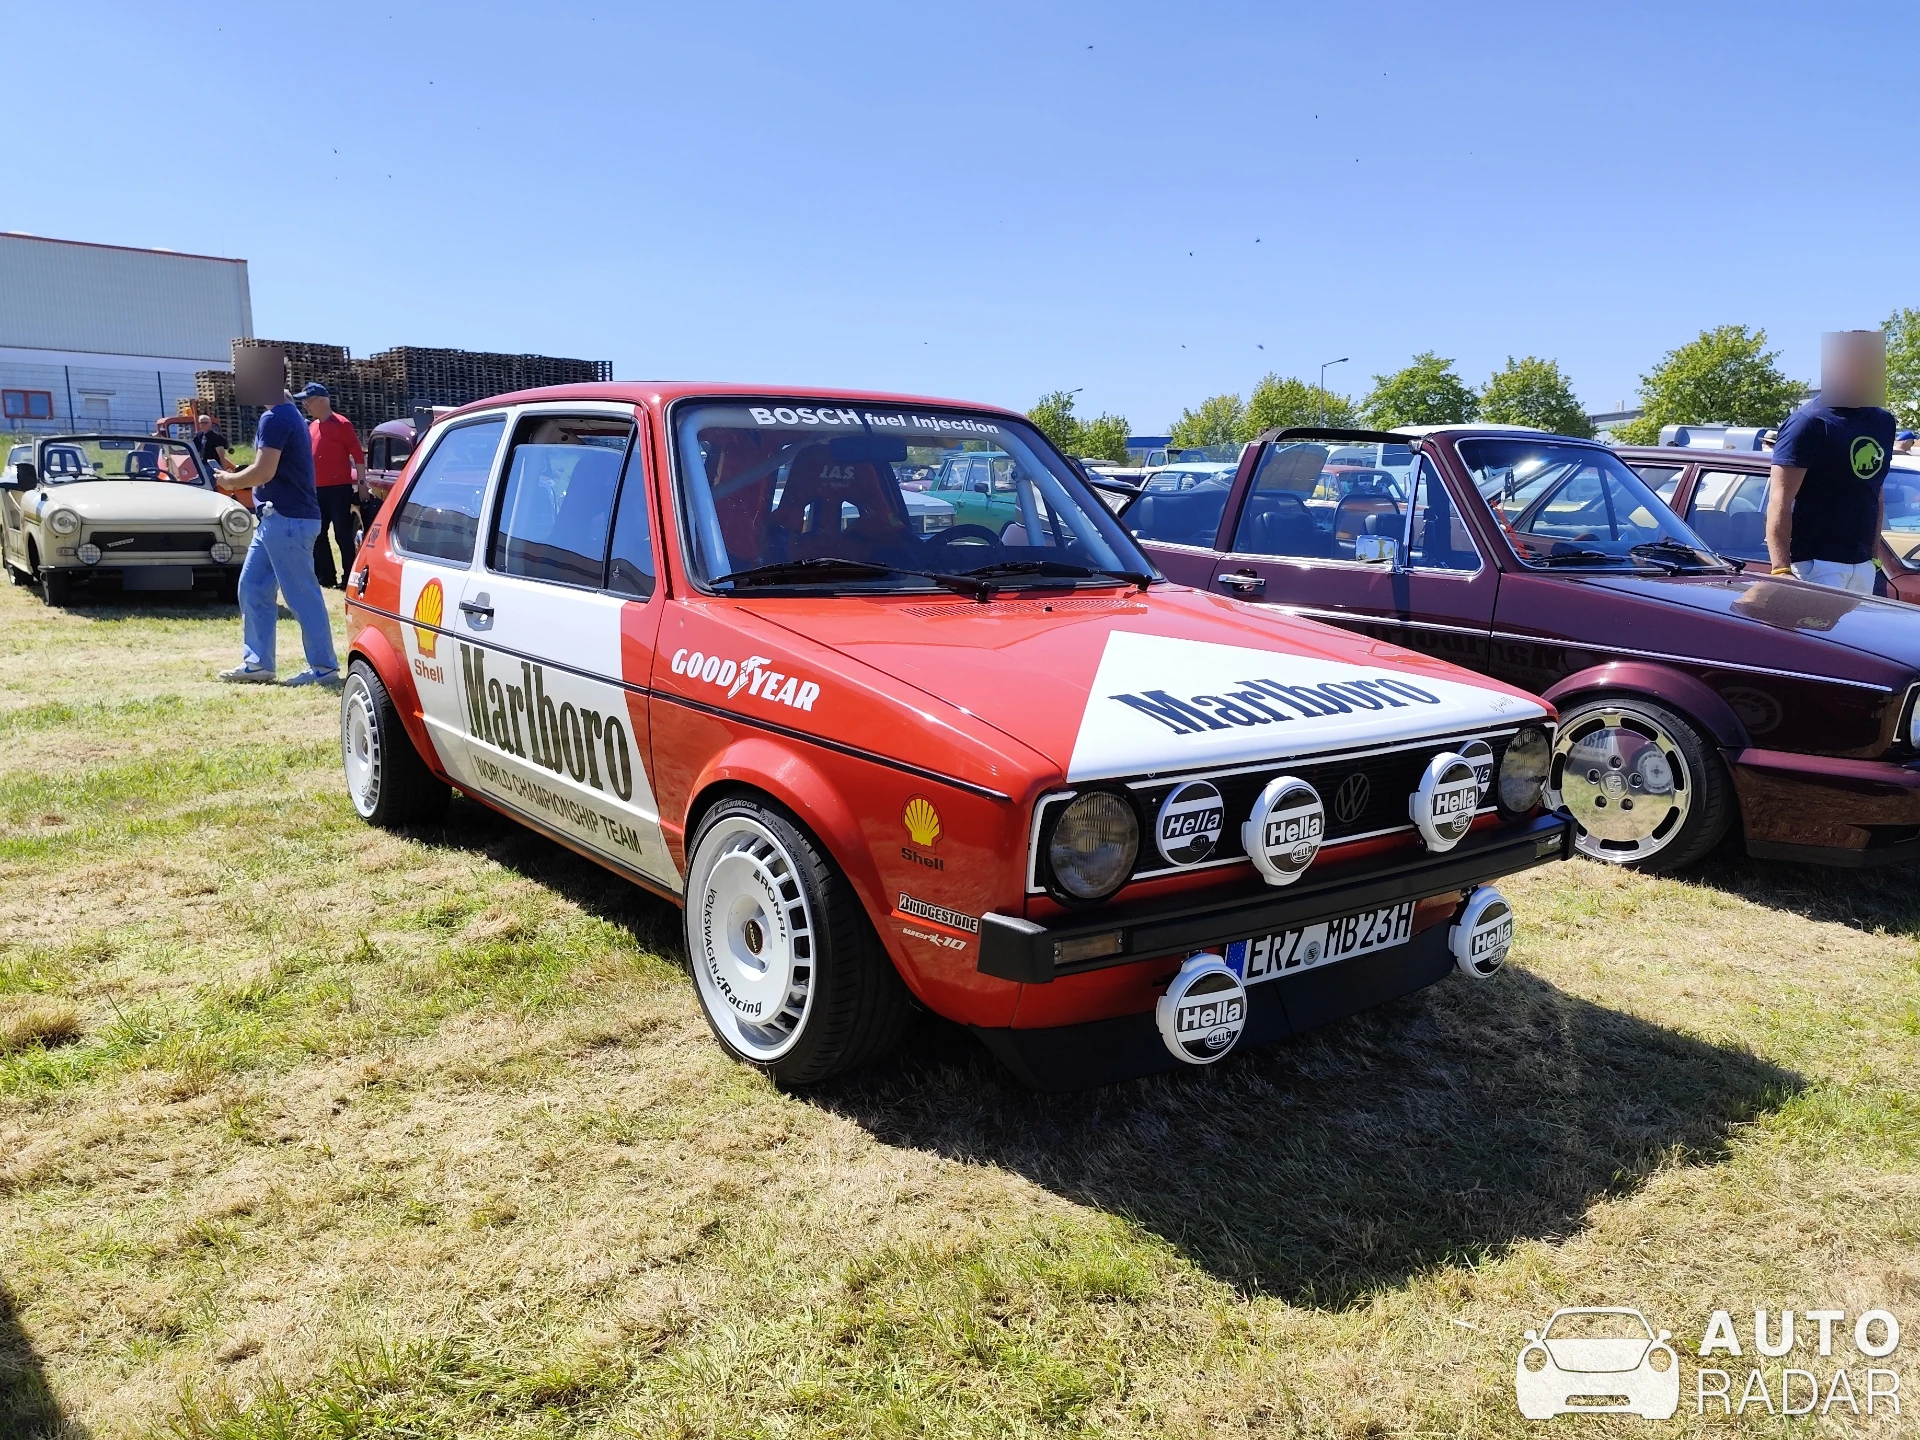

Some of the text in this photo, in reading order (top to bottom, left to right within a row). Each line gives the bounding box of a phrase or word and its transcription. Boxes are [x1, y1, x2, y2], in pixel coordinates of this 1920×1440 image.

[749, 407, 999, 434] BOSCH fuel Injection
[414, 658, 445, 684] Shell
[1107, 678, 1441, 735] Marlboro
[460, 643, 633, 802] Marlboro
[474, 755, 643, 855] WORLD CHAMPIONSHIP TEAM
[1436, 788, 1475, 815] Hella
[1165, 811, 1220, 837] Hella
[1269, 816, 1320, 845] Hella
[901, 848, 945, 872] Shell
[900, 894, 978, 932] BRIDGESTONE
[703, 888, 763, 1017] VOLKSWAGEN Racing
[1247, 927, 1303, 979] ERZ
[1474, 923, 1511, 955] Hella
[1181, 1003, 1241, 1031] Hella
[1207, 1030, 1232, 1044] HELLA
